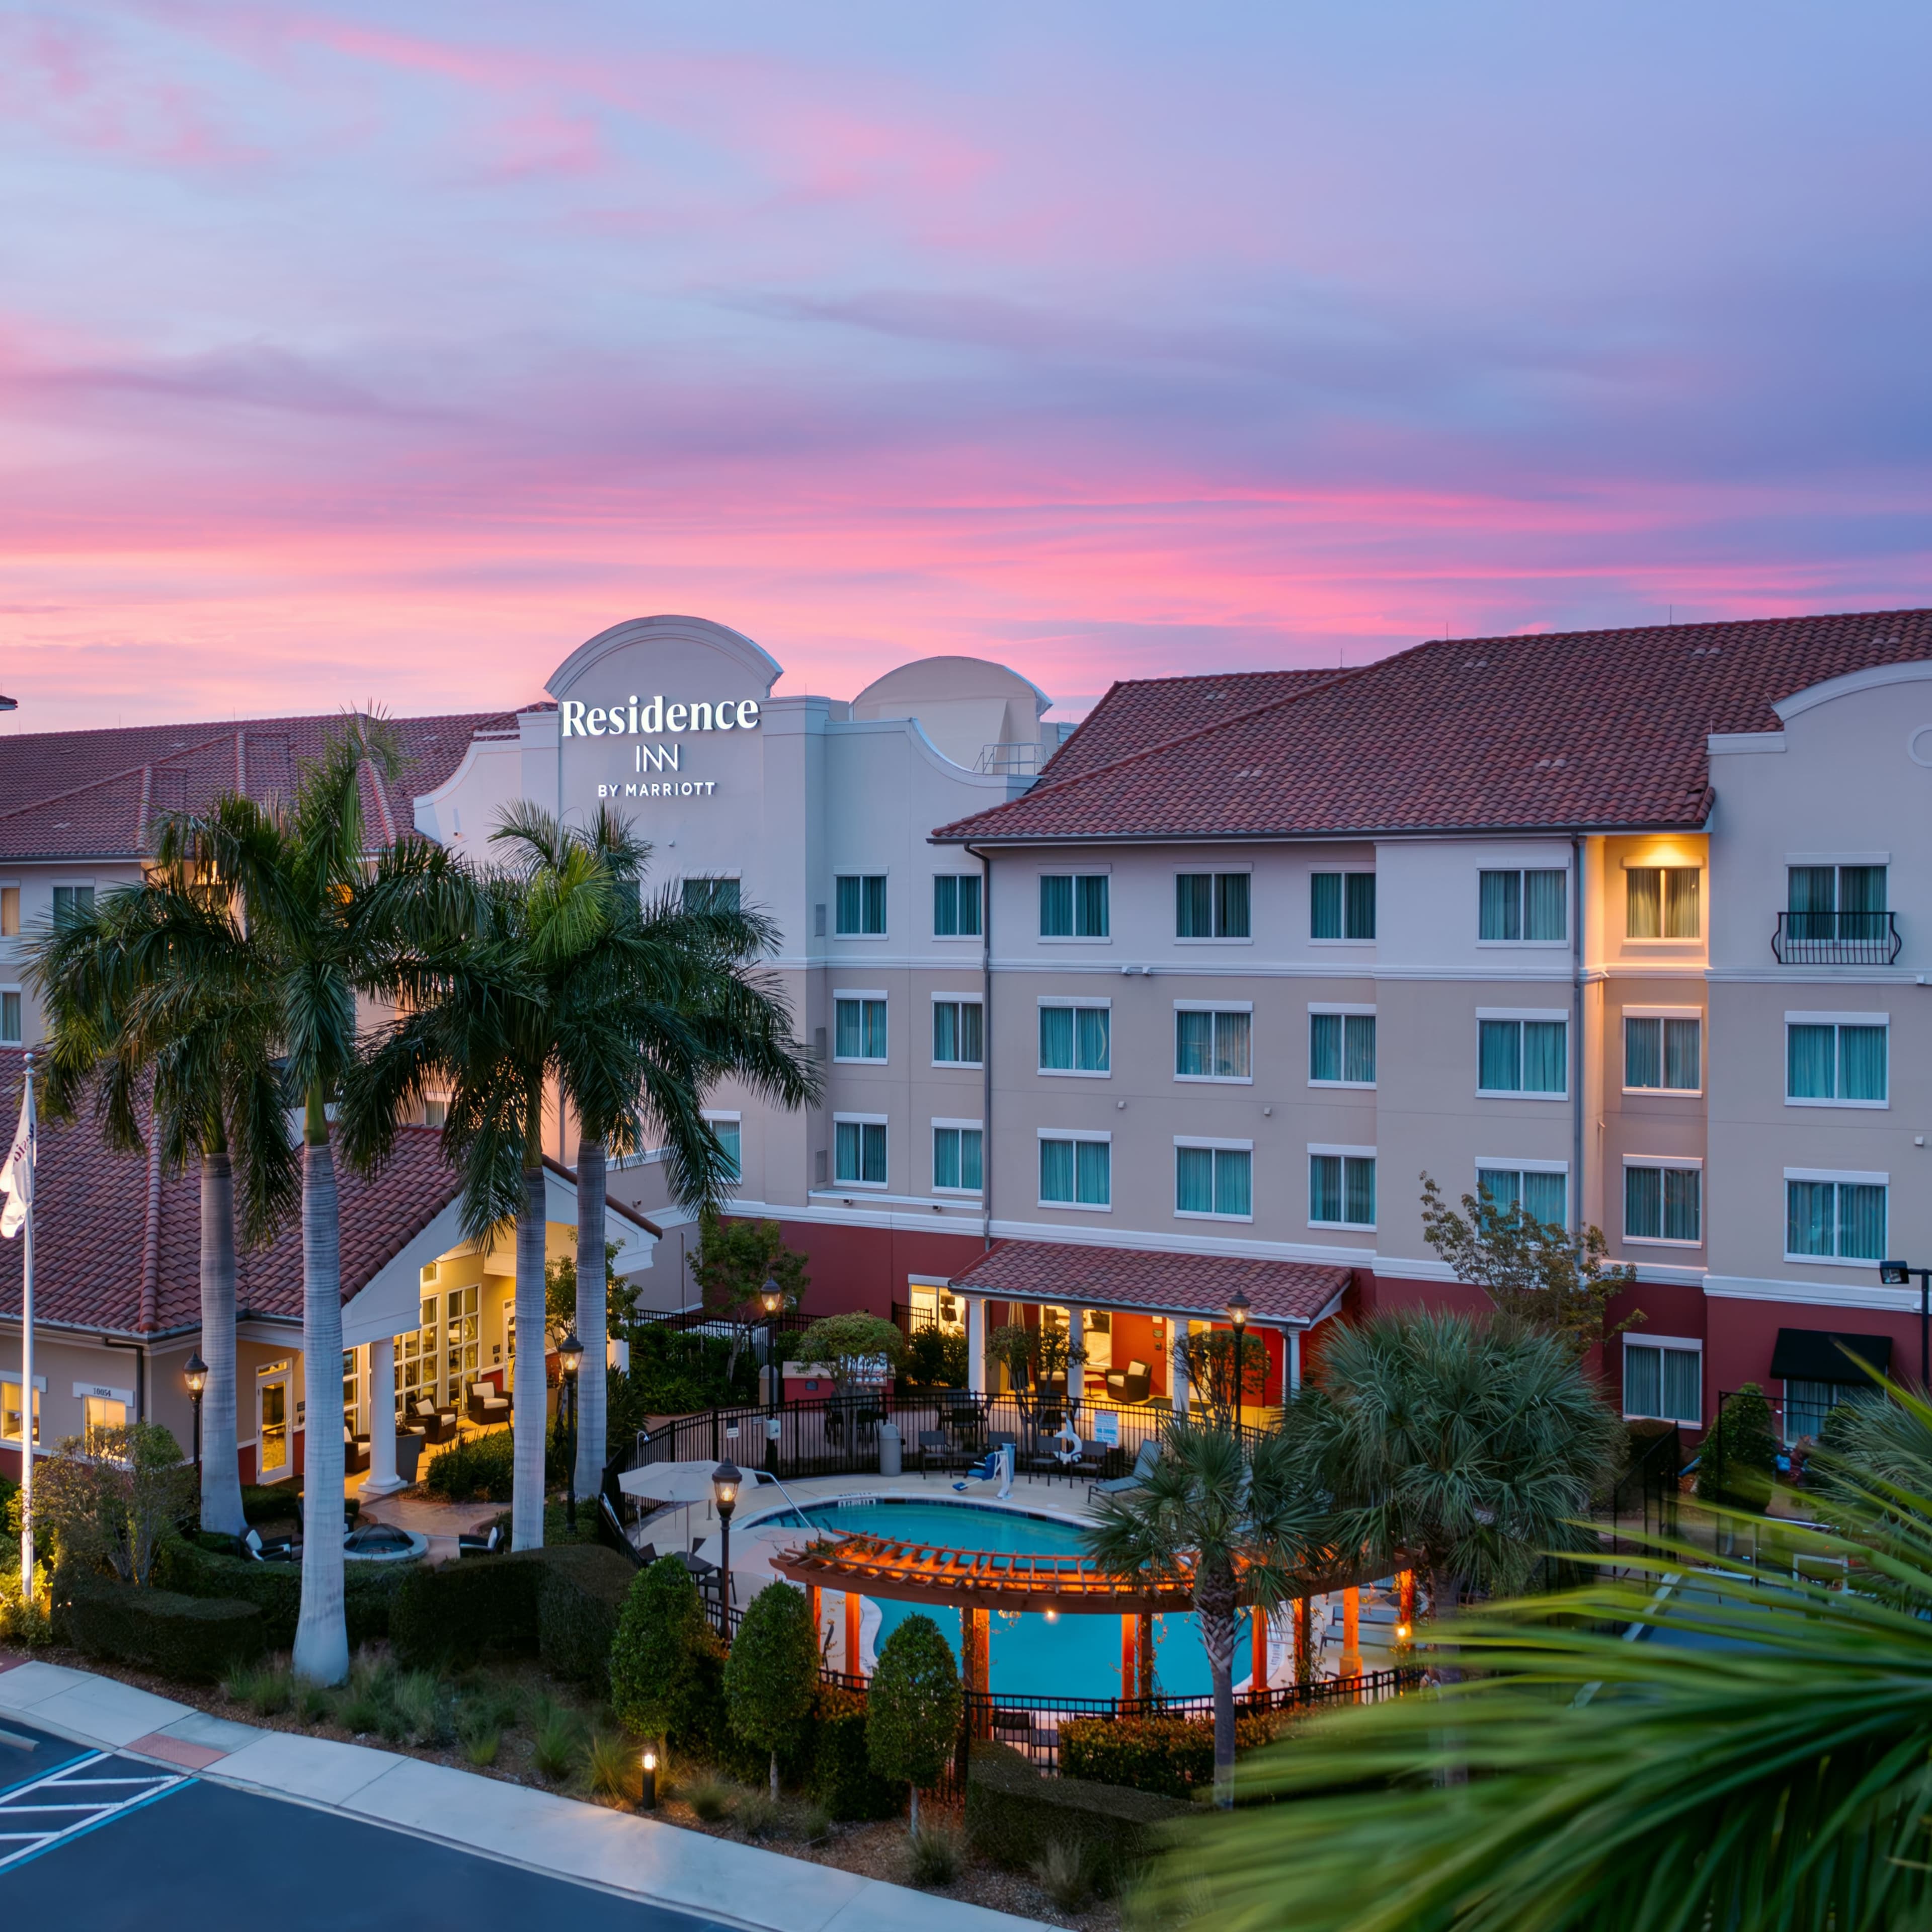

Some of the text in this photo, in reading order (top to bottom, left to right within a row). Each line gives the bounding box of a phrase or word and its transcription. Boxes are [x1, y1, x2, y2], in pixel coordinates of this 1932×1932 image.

[562, 695, 760, 737] Residence
[636, 744, 680, 772] INN
[598, 782, 715, 797] BY MARRIOTT
[93, 1388, 111, 1397] 10054
